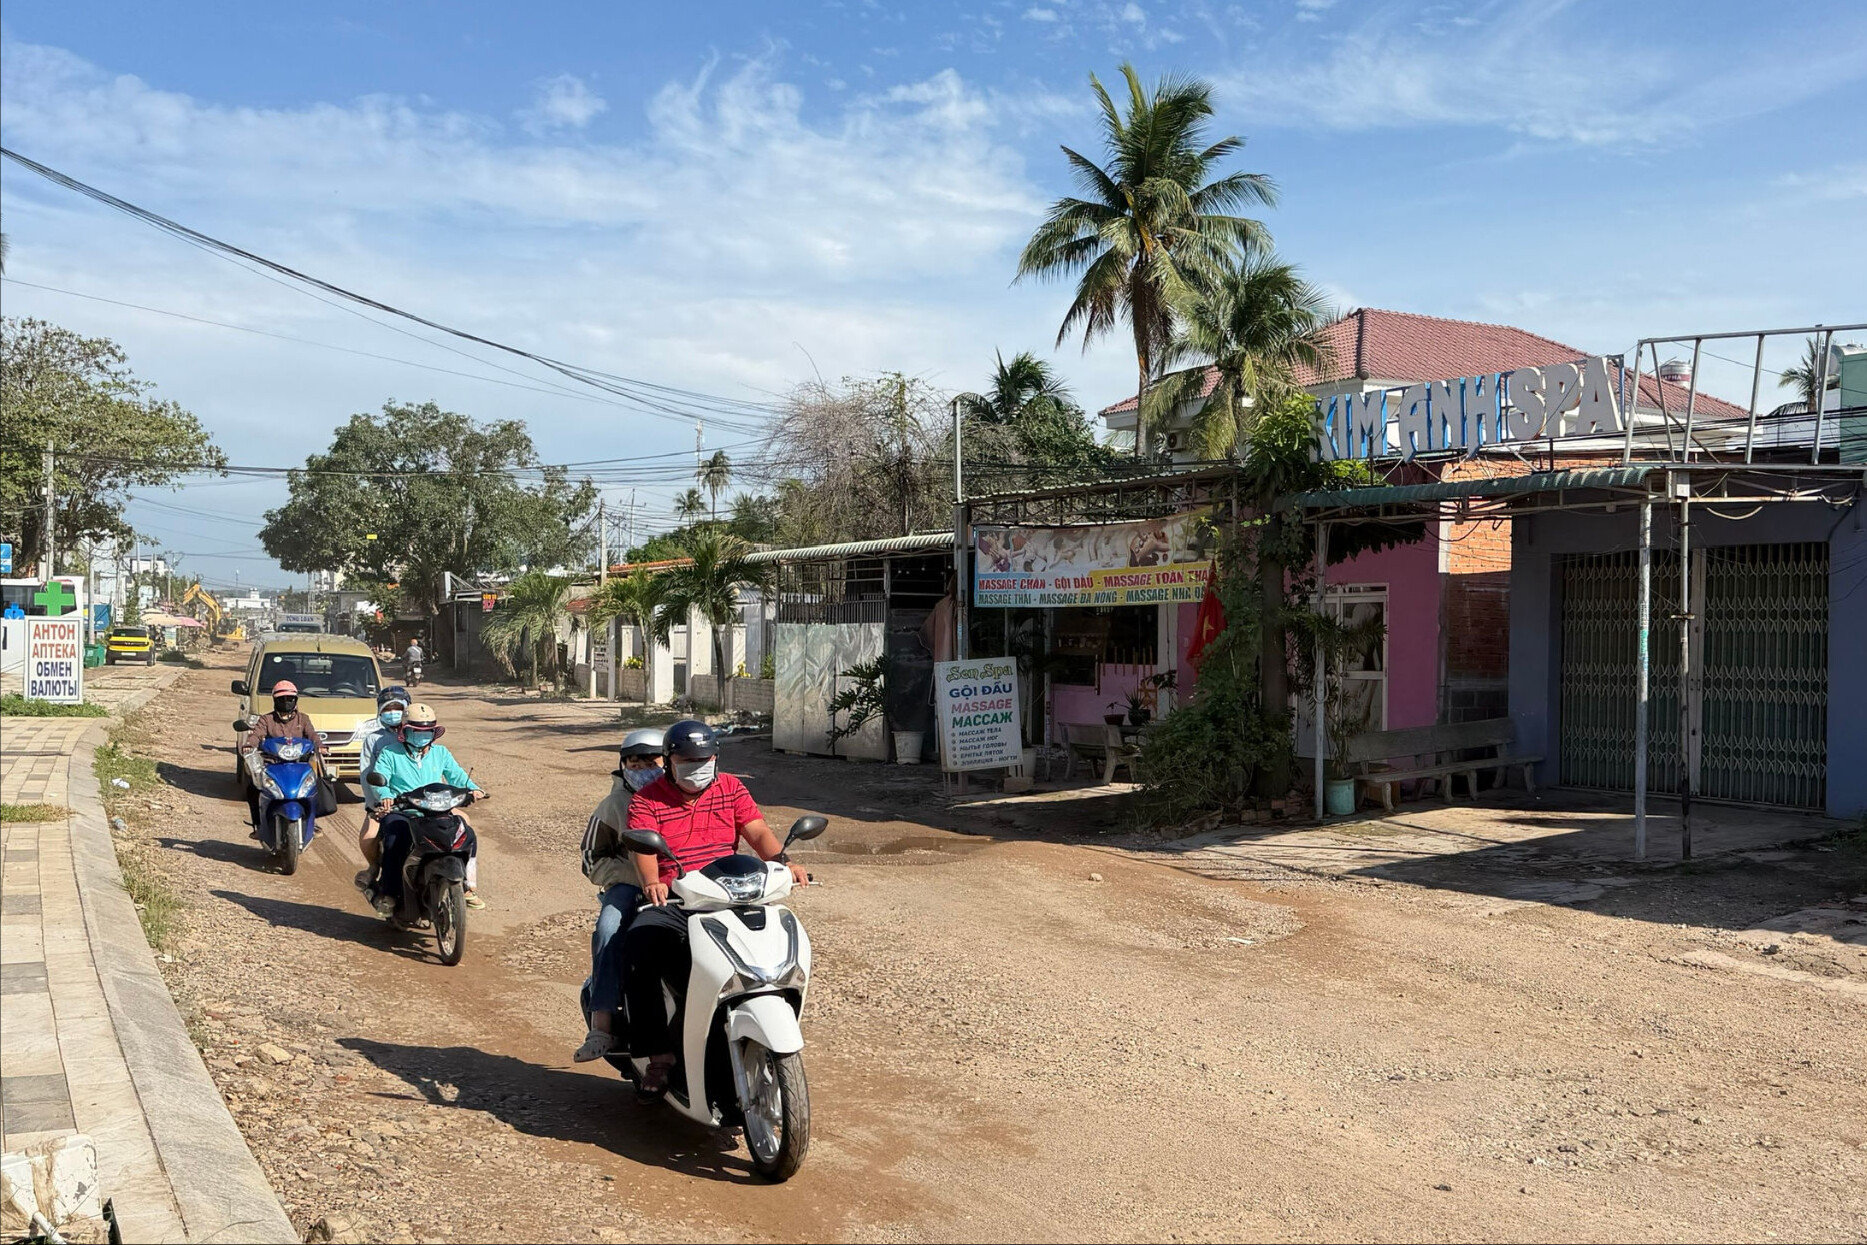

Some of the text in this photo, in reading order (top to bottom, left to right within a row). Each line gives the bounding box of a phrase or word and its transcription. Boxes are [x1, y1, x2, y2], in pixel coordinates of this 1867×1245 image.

[1508, 356, 1624, 441] SPA
[979, 578, 1017, 590] MASSAGE
[1104, 573, 1152, 588] MASSAGE
[979, 593, 1012, 605] MASSAGE
[1040, 592, 1079, 605] MASSAGE
[1126, 588, 1169, 603] MASSAGE
[33, 624, 75, 640] АНТОН
[32, 643, 76, 658] АПТЕКА
[36, 661, 72, 677] ОБМЕН
[980, 664, 1013, 680] Spa
[31, 680, 77, 696] ВАЛЮТЫ
[949, 684, 978, 700] GỘI
[951, 699, 1013, 714] MASSAGE
[952, 711, 1013, 729] МАССАЖ
[959, 728, 985, 736] МАССАЖ
[959, 736, 985, 744] МАССАЖ
